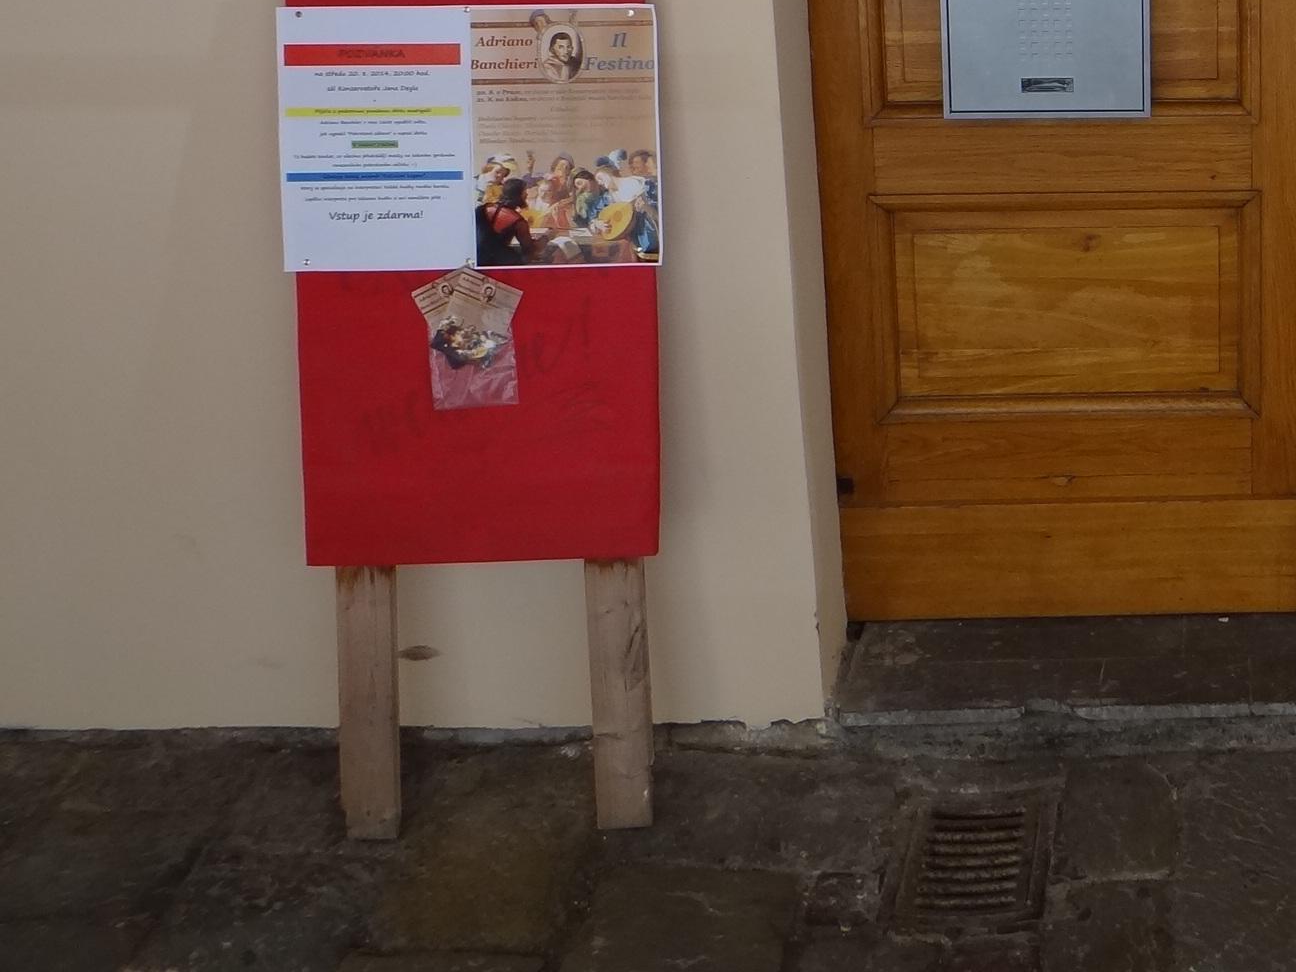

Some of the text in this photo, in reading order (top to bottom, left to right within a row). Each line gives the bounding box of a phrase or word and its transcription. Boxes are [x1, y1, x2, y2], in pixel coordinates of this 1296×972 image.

[475, 35, 534, 47] Adriano
[610, 32, 627, 48] Il
[470, 57, 538, 70] Banchieri
[582, 56, 655, 71] Festino
[329, 209, 424, 223] Vstup je zdarma!
